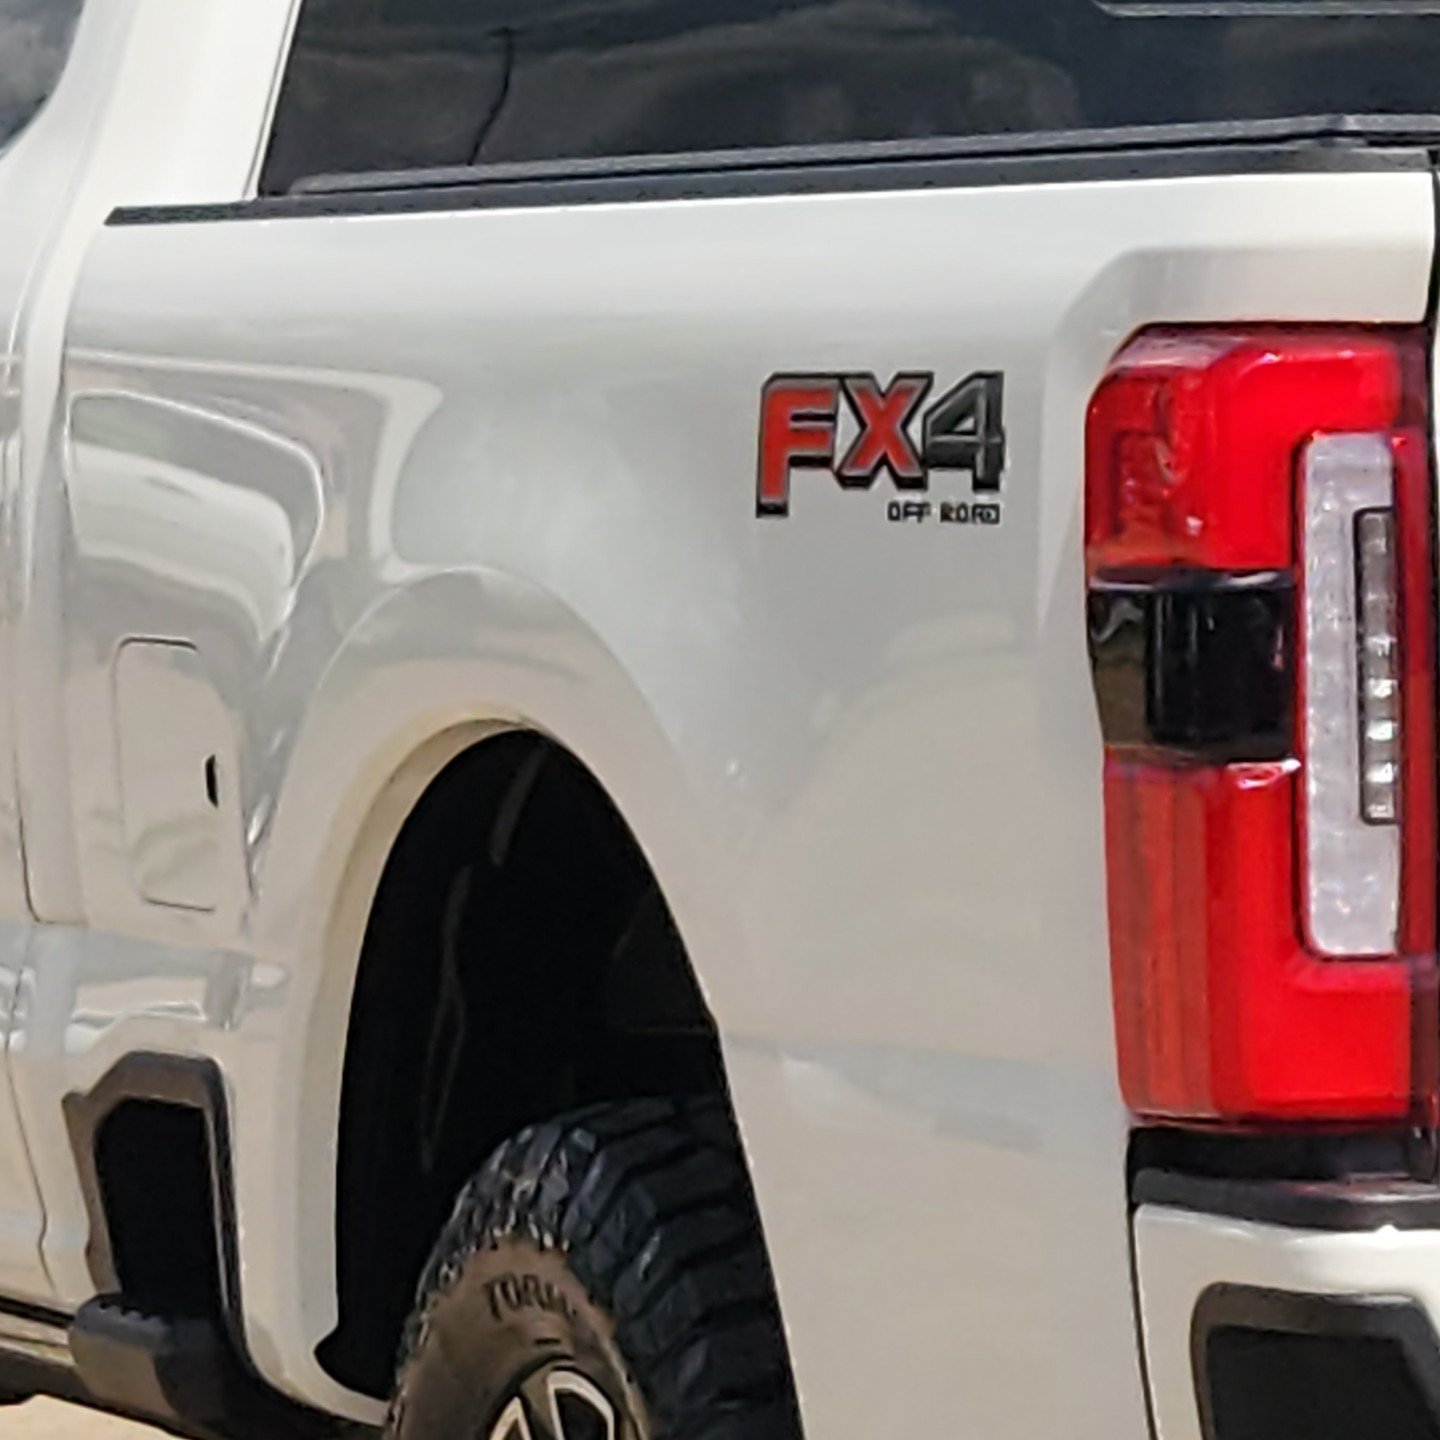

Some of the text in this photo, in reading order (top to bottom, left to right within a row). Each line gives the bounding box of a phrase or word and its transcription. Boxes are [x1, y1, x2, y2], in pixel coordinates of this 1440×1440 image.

[756, 371, 1004, 518] FX4
[887, 501, 1001, 525] OFF ROAD
